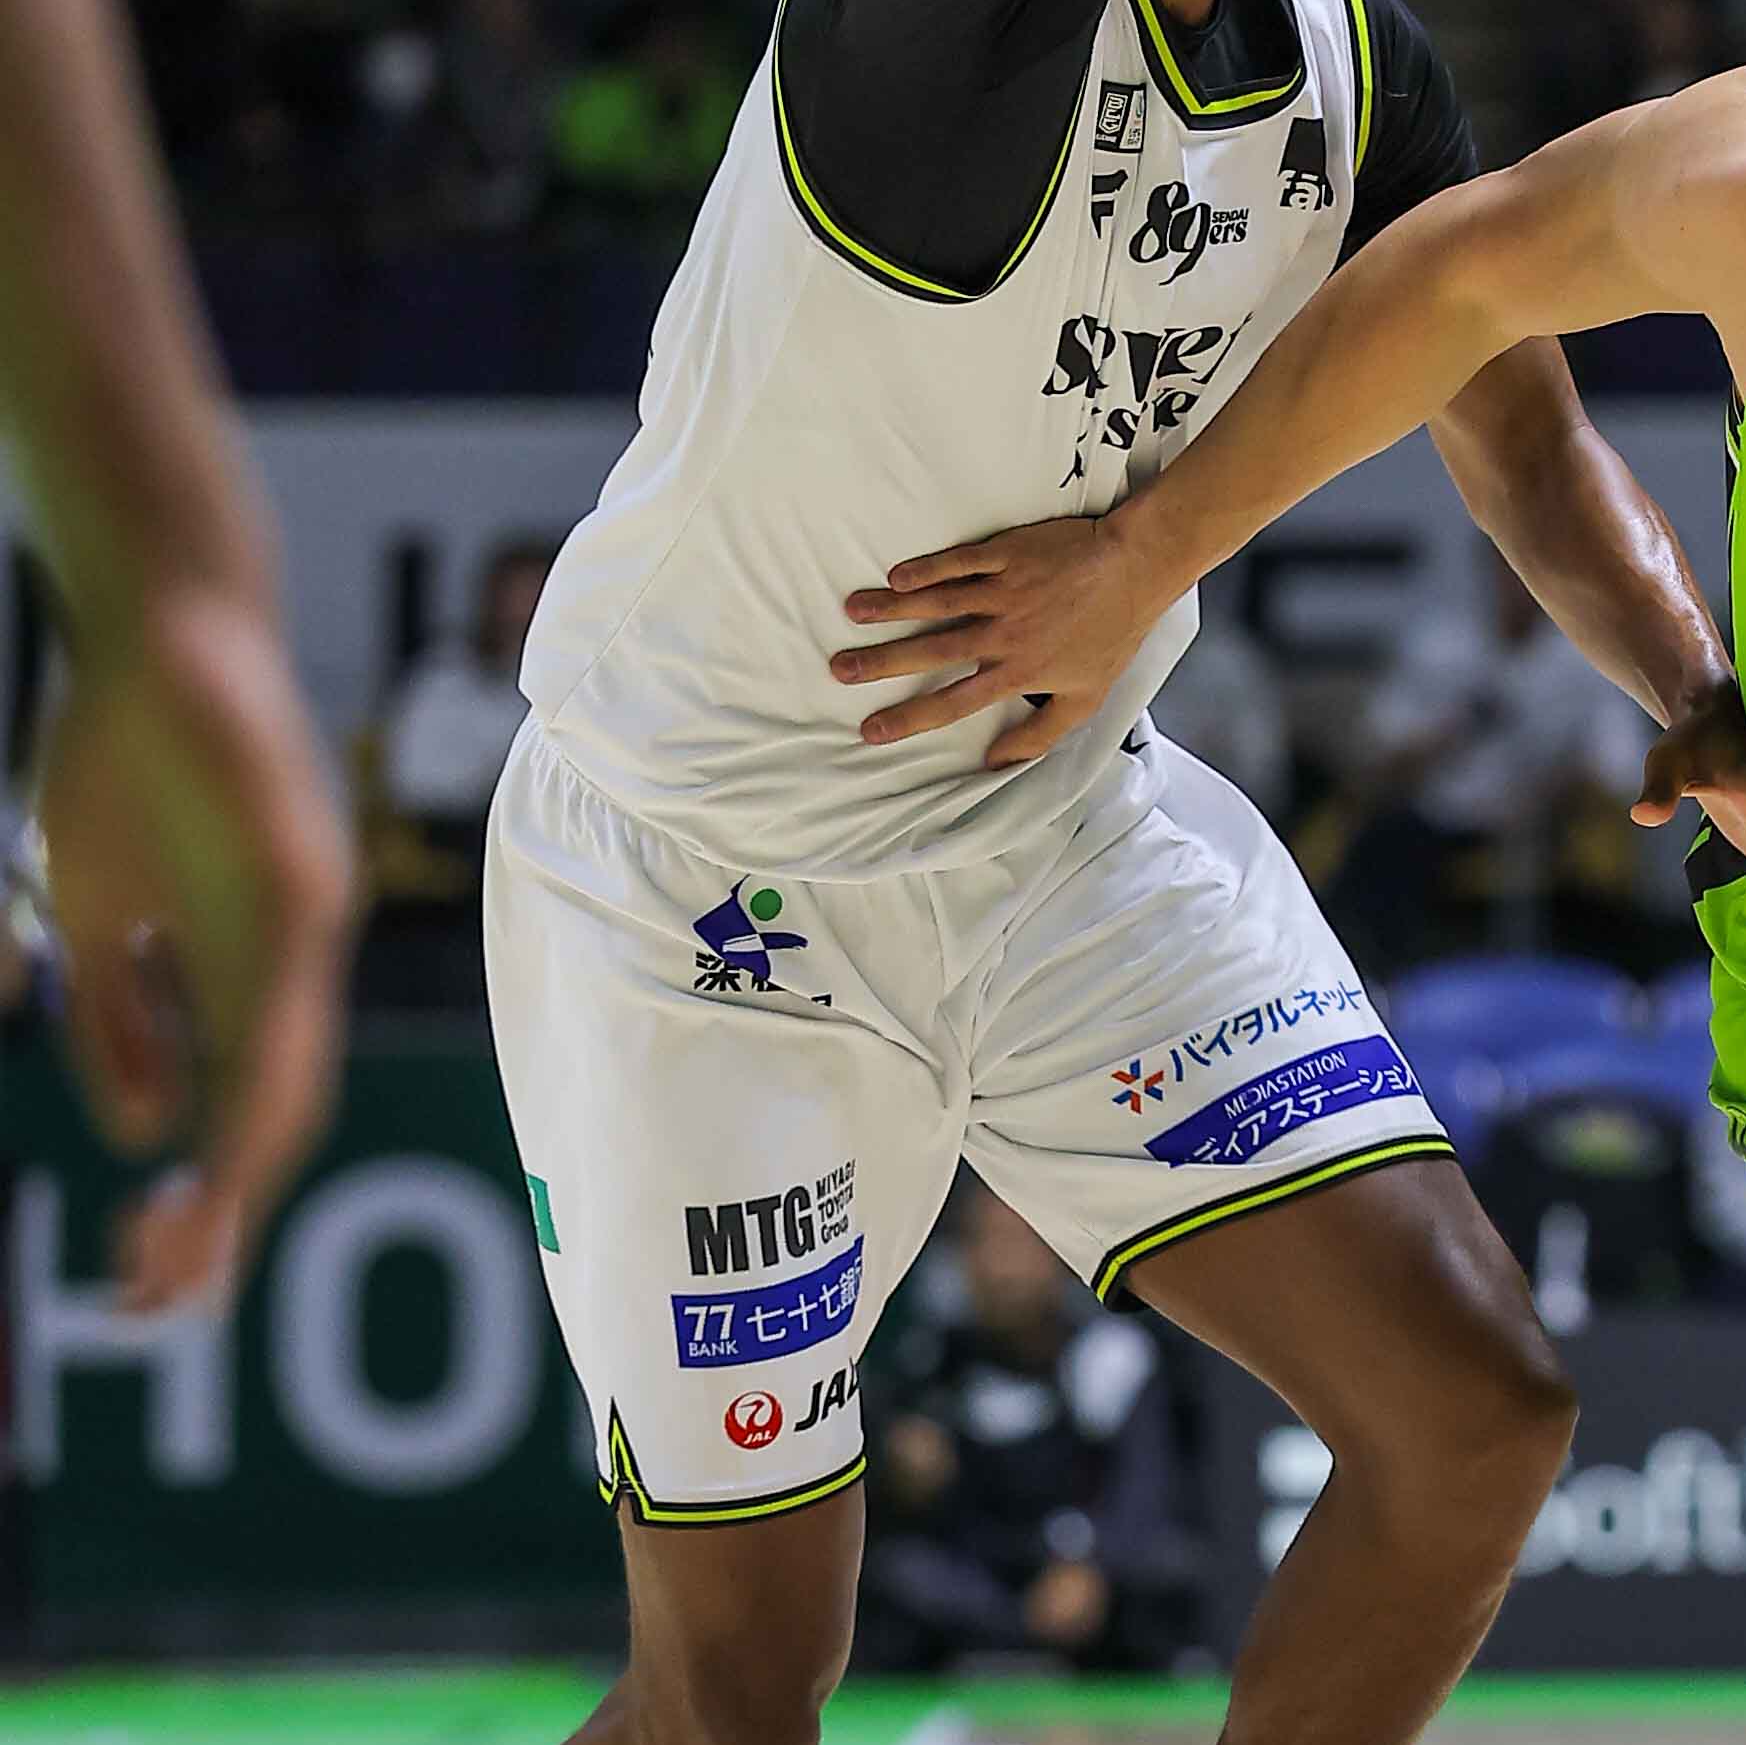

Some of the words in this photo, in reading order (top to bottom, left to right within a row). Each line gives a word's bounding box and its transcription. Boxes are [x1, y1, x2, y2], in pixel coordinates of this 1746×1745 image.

[1212, 207, 1249, 224] SENDAI
[1169, 981, 1362, 1082] バイタルネット
[1223, 1050, 1347, 1119] MEDIASTATION
[685, 1185, 816, 1276] MTG
[820, 1214, 849, 1244] Group
[684, 1303, 736, 1342] 77
[688, 1340, 739, 1358] BANK
[744, 1430, 773, 1445] JAL
